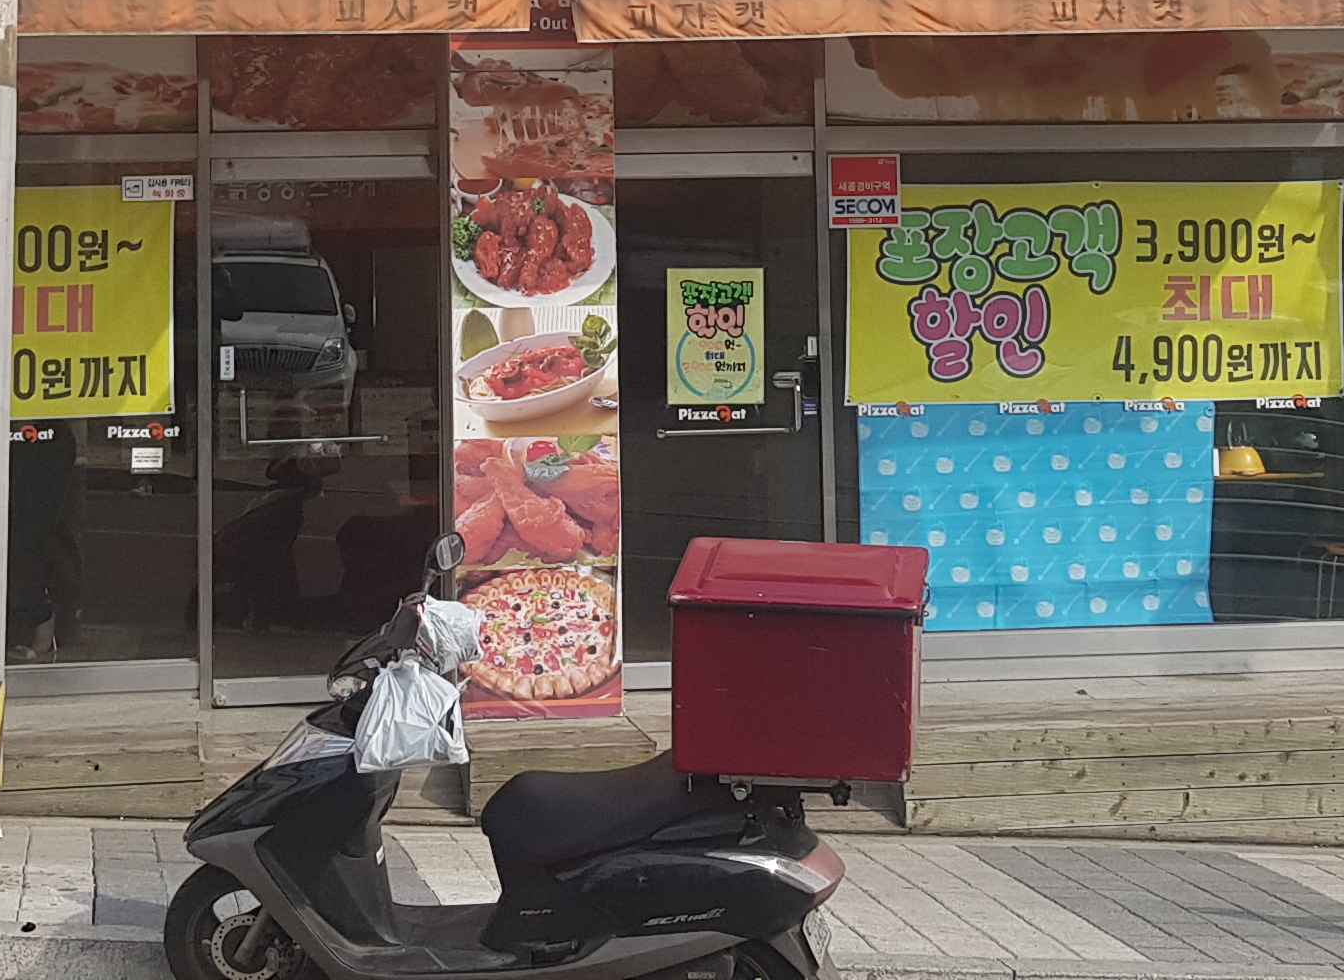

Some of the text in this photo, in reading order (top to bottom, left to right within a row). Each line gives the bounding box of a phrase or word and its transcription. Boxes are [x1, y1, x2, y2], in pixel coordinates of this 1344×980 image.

[834, 198, 896, 215] SECOM
[876, 199, 1317, 295] 포장고객 3,900원~
[680, 280, 753, 305] 포장고객
[685, 302, 746, 339] 할인
[907, 274, 1273, 384] 할인 최대
[1111, 334, 1323, 386] 4,900원까지
[107, 422, 181, 442] PizzaCat
